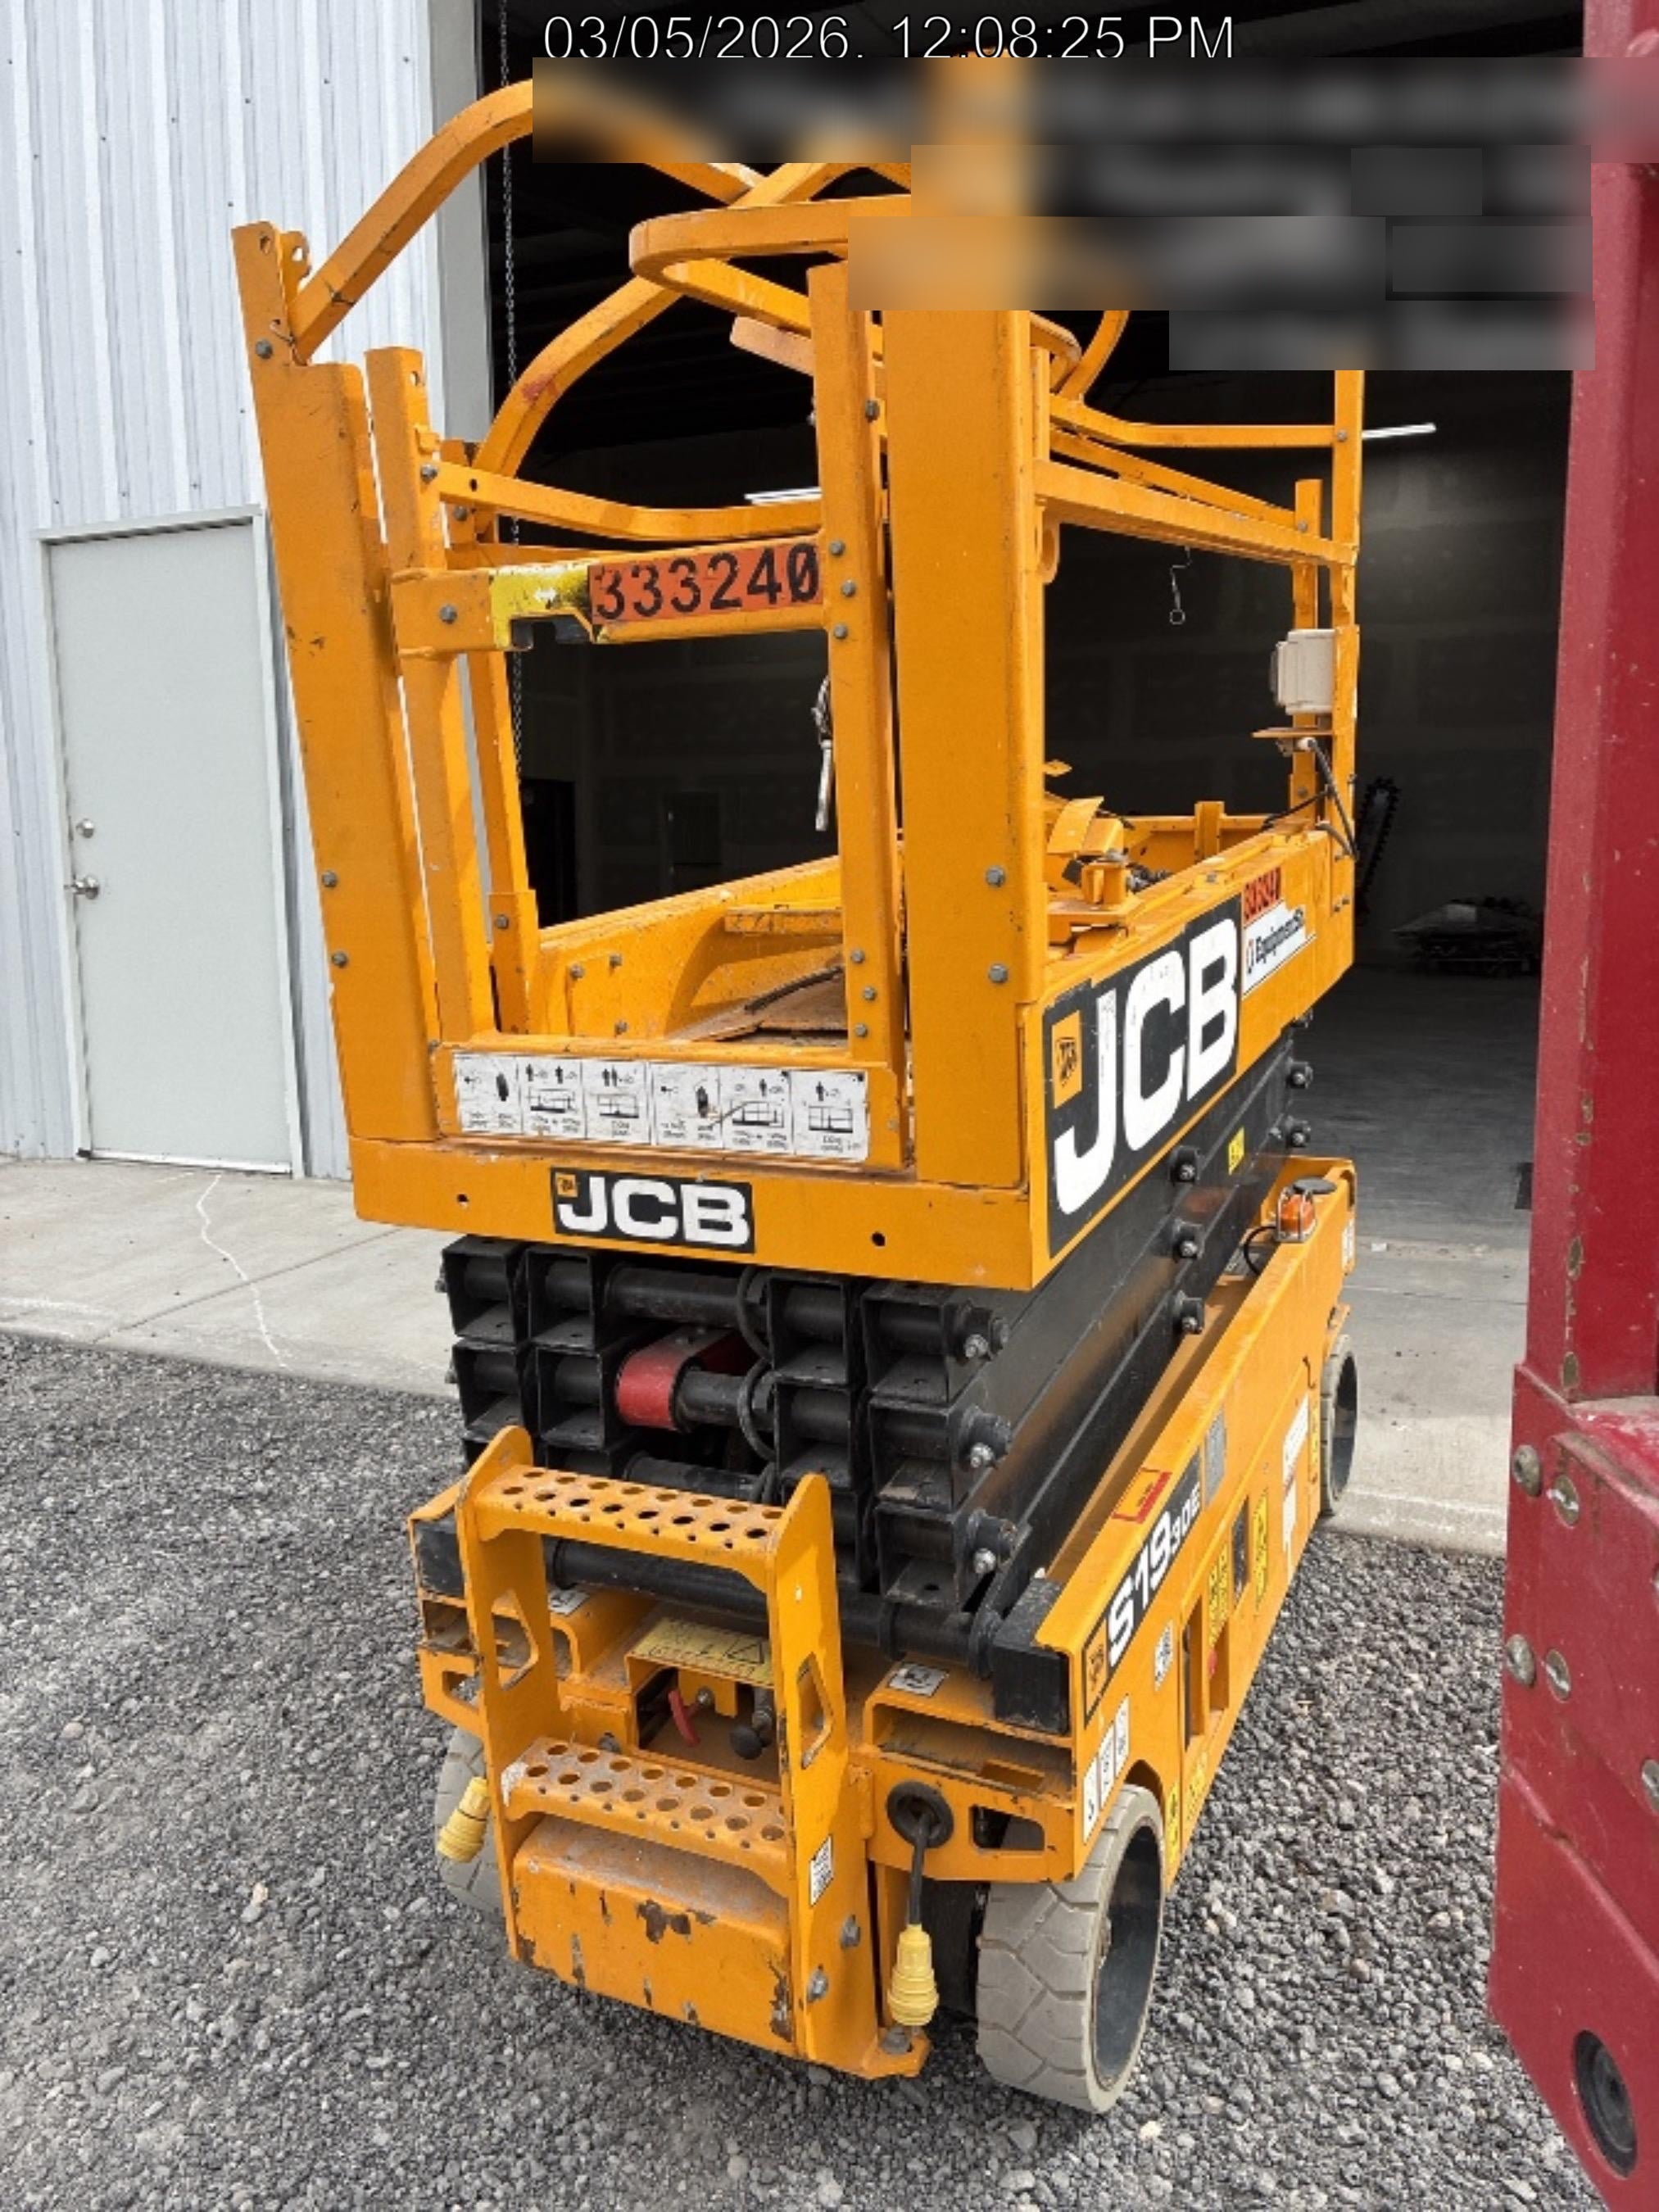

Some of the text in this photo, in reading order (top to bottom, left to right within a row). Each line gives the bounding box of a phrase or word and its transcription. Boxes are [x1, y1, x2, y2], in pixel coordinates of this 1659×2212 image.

[594, 542, 819, 620] 333240
[1054, 918, 1238, 1216] JCB
[557, 1176, 750, 1246] JCB
